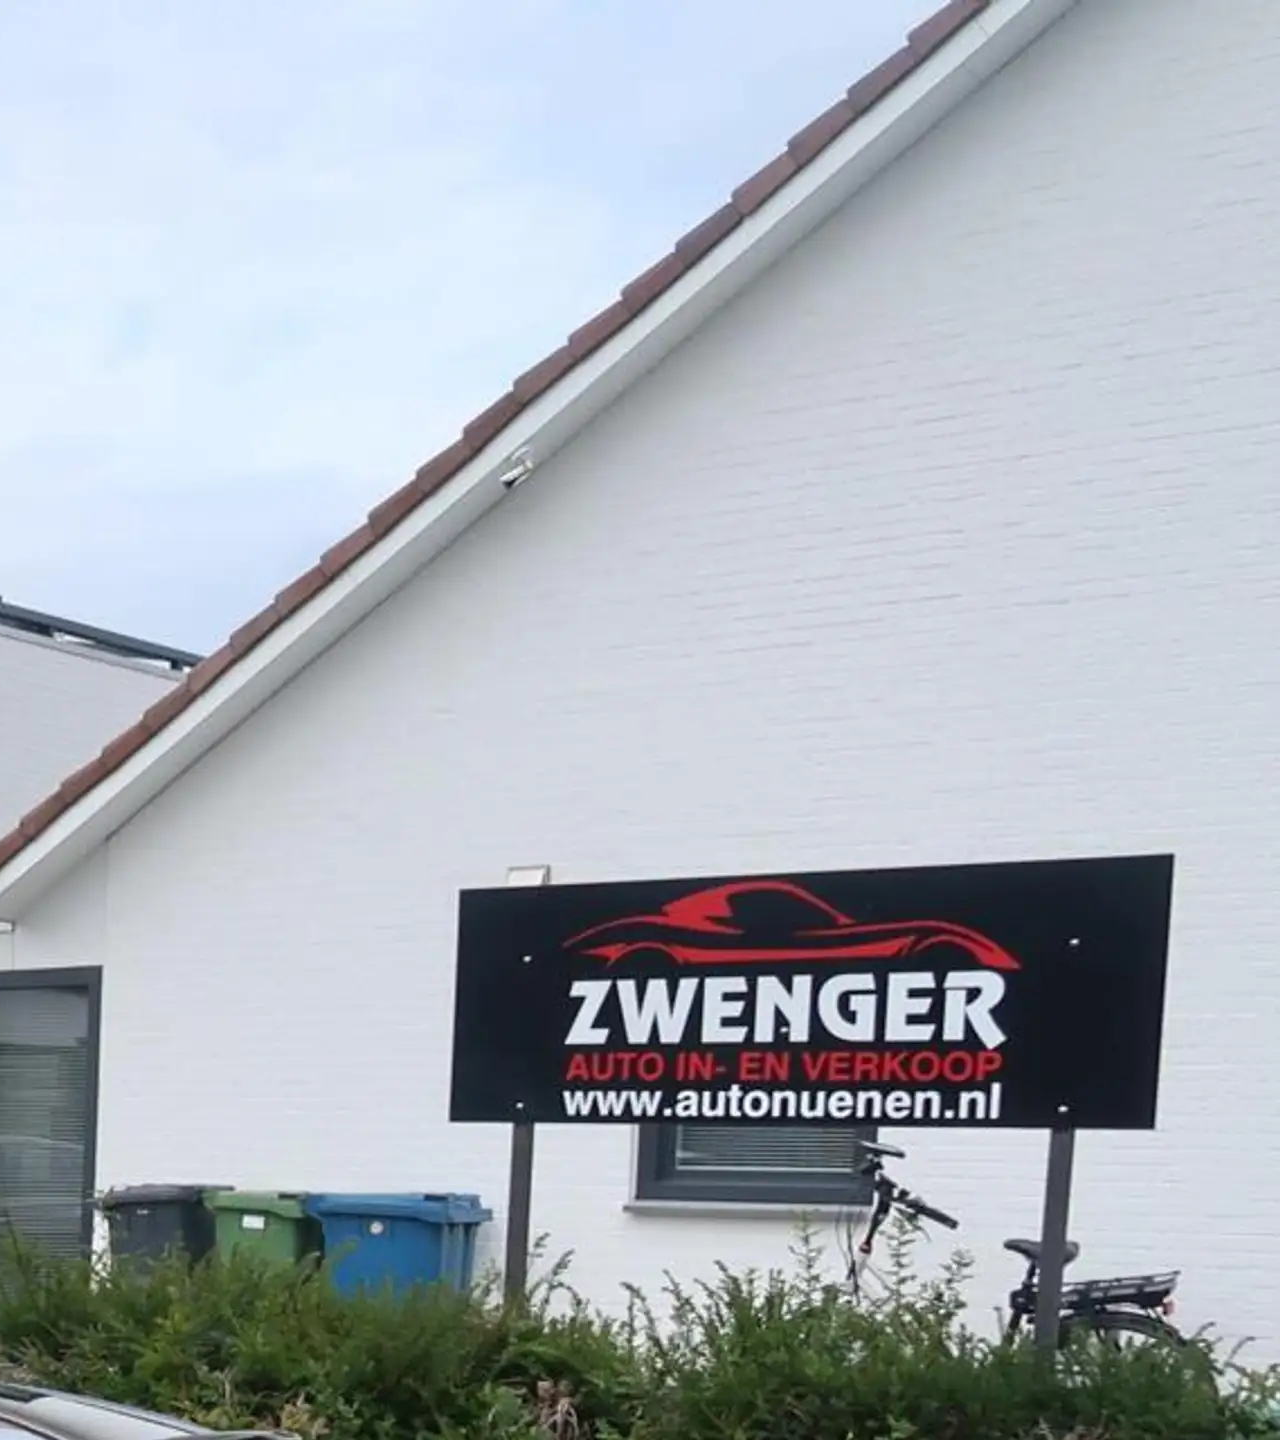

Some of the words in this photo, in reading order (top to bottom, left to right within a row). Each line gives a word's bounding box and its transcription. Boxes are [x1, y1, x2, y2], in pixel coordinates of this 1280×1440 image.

[564, 970, 1008, 1050] ZWENGER
[565, 1052, 666, 1082] AUTO
[675, 1052, 727, 1082] IN-
[740, 1052, 791, 1082] EN
[801, 1051, 1004, 1082] VERKOOP
[563, 1082, 1003, 1120] www.autonuenen.nl
